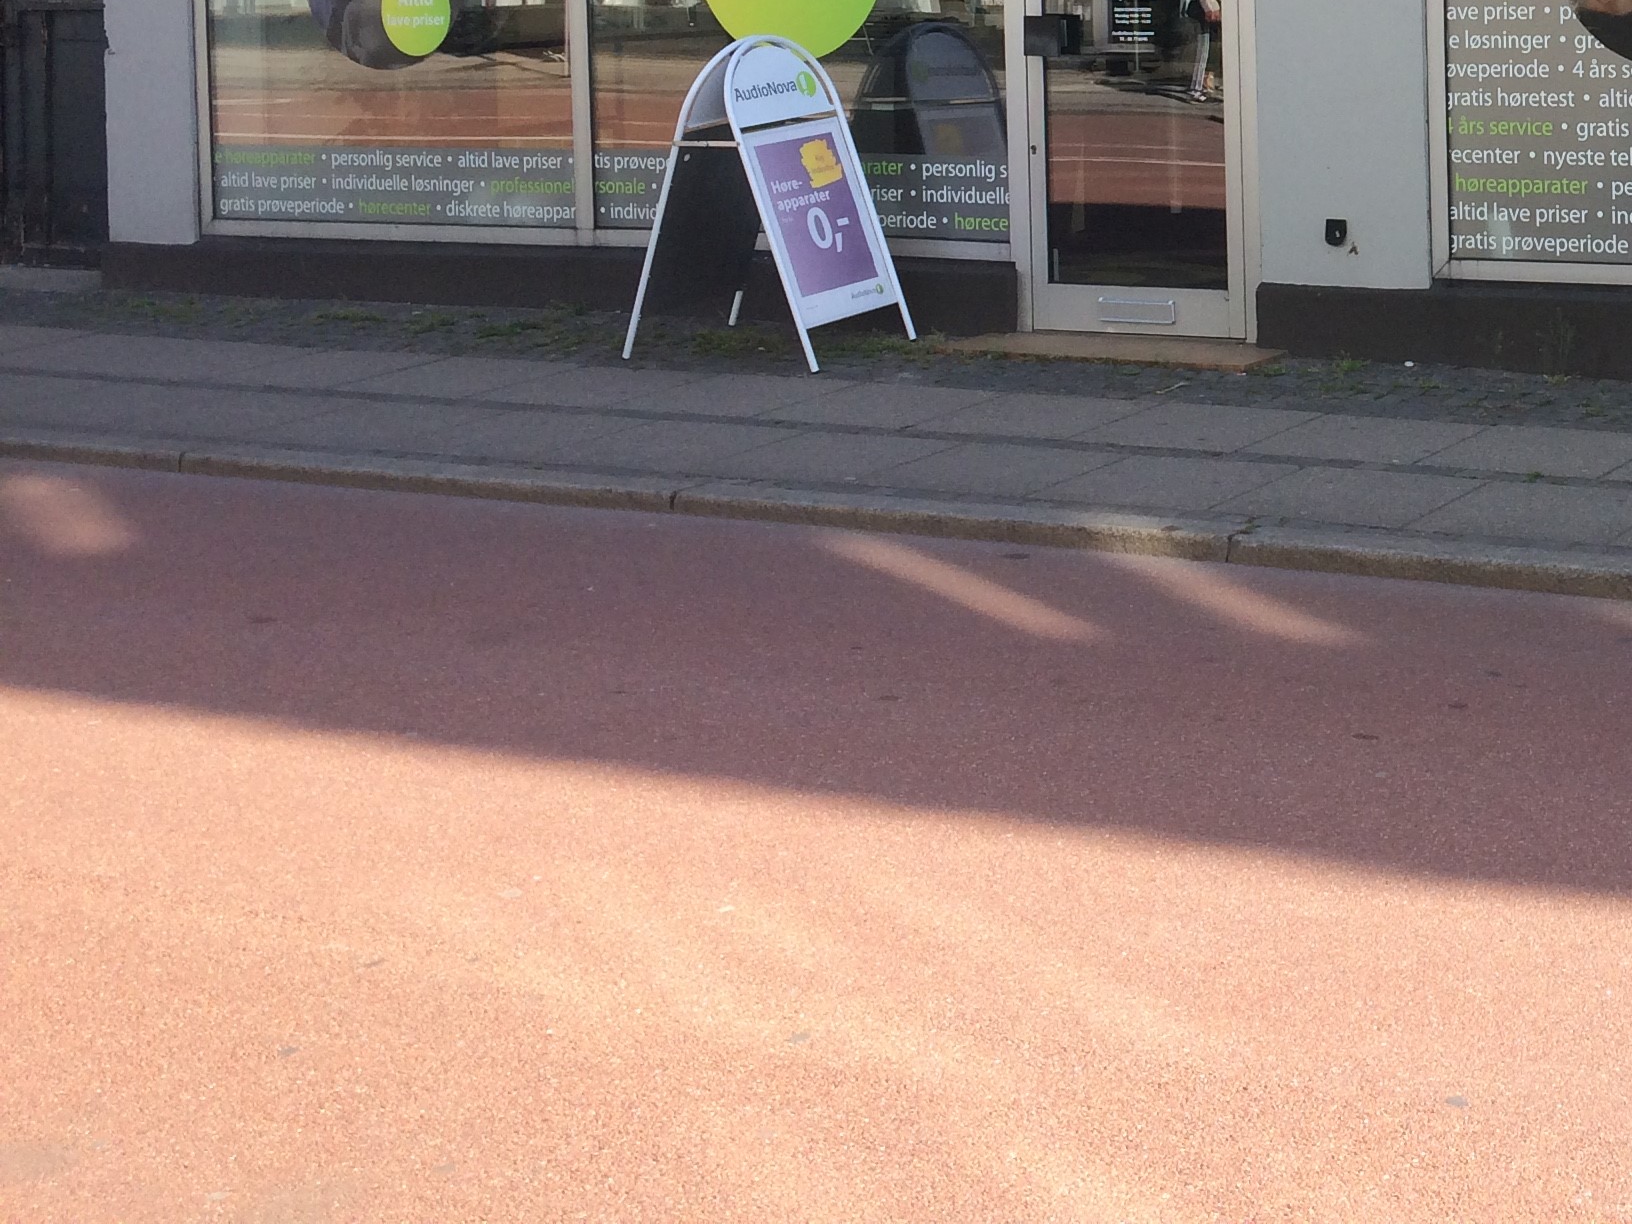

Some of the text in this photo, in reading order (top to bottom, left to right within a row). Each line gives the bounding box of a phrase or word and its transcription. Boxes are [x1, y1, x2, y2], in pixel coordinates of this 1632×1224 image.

[387, 14, 445, 28] lave priser
[1447, 2, 1536, 24] ave priser
[1465, 30, 1551, 54] løsninger
[1447, 59, 1550, 82] øveperiode
[1572, 62, 1584, 78] 4
[1590, 59, 1616, 78] års
[735, 78, 797, 102] AudioNova
[1497, 88, 1575, 107] høretest
[1459, 115, 1484, 135] års
[1490, 118, 1553, 136] service
[1577, 118, 1629, 141] gratis
[331, 151, 392, 171] personlig
[396, 151, 441, 168] service
[458, 150, 487, 167] altid
[492, 150, 519, 168] lave
[523, 151, 562, 172] priser
[922, 160, 995, 182] personlig
[1544, 150, 1604, 169] nyeste
[221, 172, 574, 196] altid lave priser individuelle løsninger professionel
[771, 179, 803, 195] Høre-
[1455, 173, 1588, 197] høreapparater
[220, 197, 500, 218] gratis prøveperiode hørecenter diskrete
[777, 190, 831, 213] apparater
[1450, 202, 1488, 221] altid
[1494, 203, 1530, 222] lave
[1536, 205, 1588, 226] priser
[1450, 231, 1497, 252] gratis
[1503, 234, 1629, 256] prøveperiode
